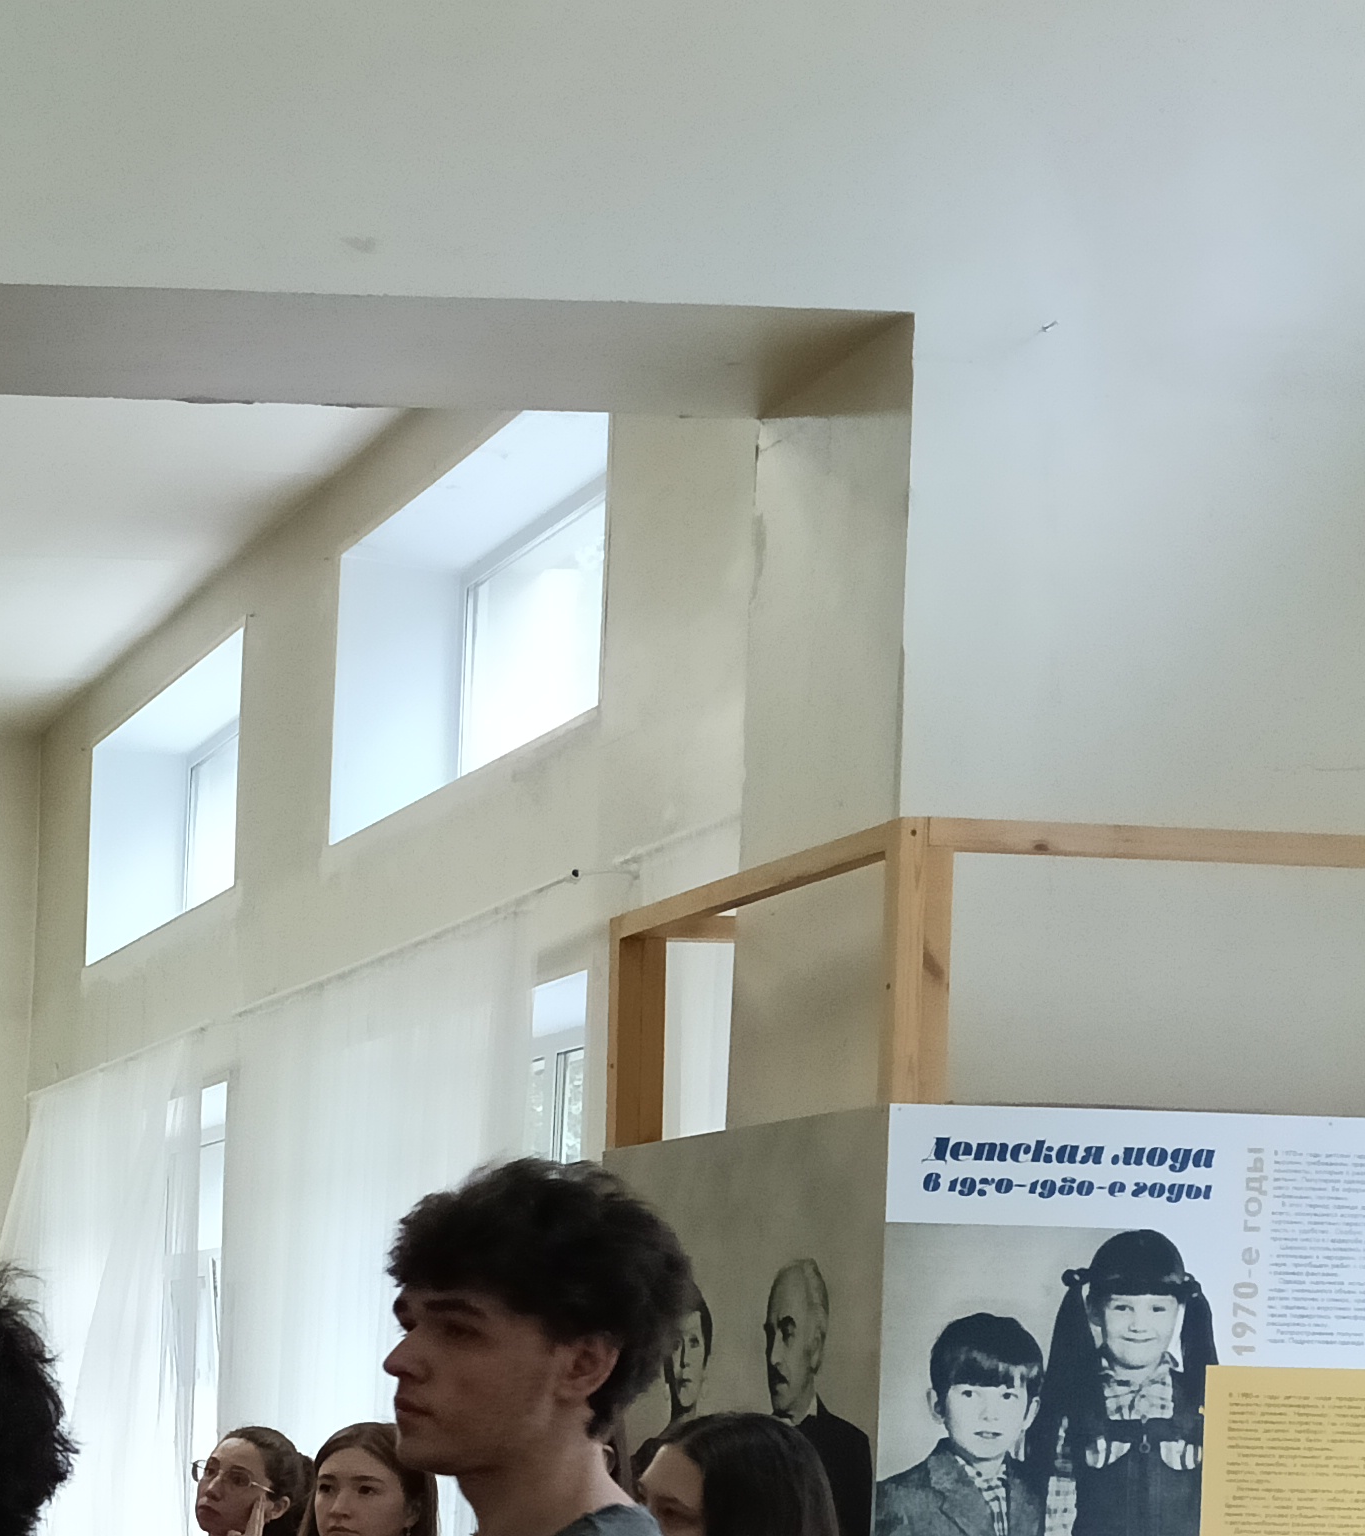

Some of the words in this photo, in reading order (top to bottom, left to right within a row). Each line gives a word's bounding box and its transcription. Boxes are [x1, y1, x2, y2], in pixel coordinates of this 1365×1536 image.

[921, 1136, 1105, 1166] Детская
[1111, 1146, 1216, 1173] мода
[922, 1172, 942, 1193] в
[1131, 1181, 1213, 1204] годы
[1243, 1147, 1269, 1233] годы
[1231, 1246, 1261, 1356] 1970-е
